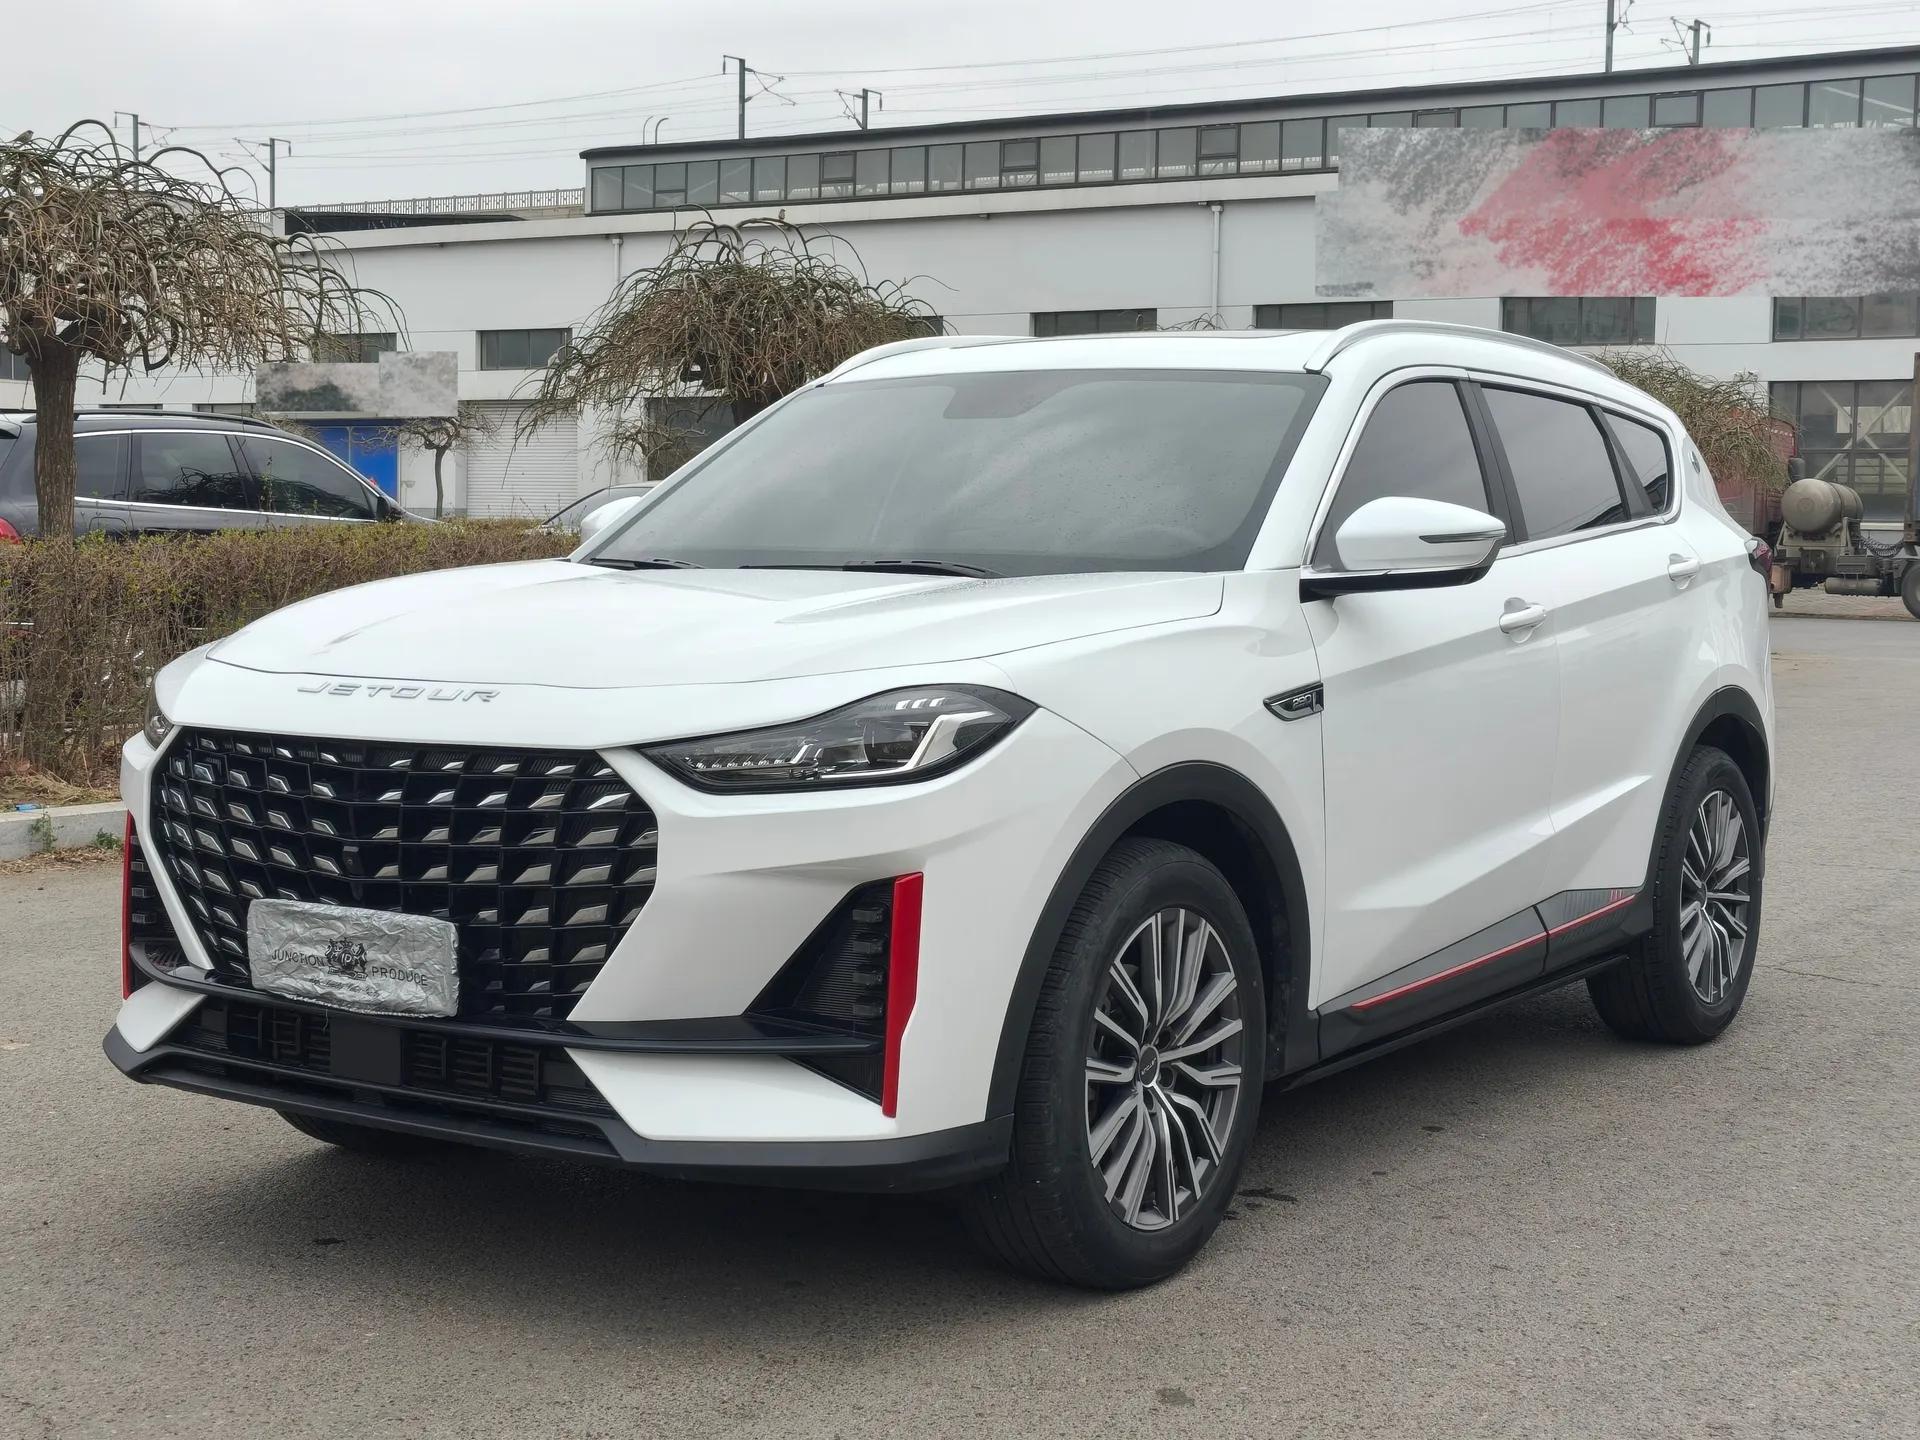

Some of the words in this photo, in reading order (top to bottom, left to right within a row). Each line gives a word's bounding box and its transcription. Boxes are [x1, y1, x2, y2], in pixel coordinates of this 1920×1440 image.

[297, 682, 501, 702] JETOUR
[271, 949, 325, 967] JUNCTION
[371, 965, 428, 986] PRODUCE
